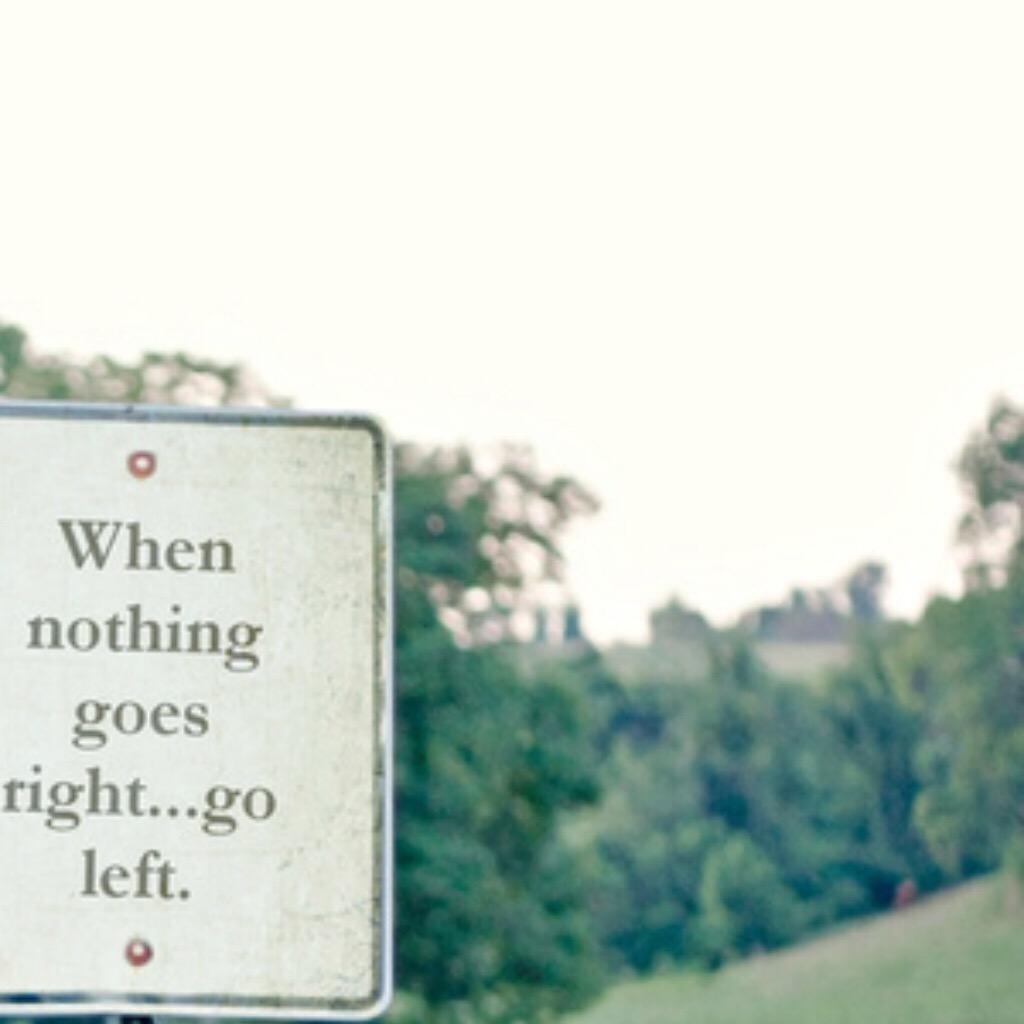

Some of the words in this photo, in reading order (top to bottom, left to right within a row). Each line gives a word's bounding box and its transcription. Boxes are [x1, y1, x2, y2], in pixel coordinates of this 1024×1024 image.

[58, 519, 236, 573] When
[27, 603, 264, 672] nothing
[72, 700, 209, 749] goes
[3, 765, 277, 836] right...go
[81, 848, 190, 900] left.
